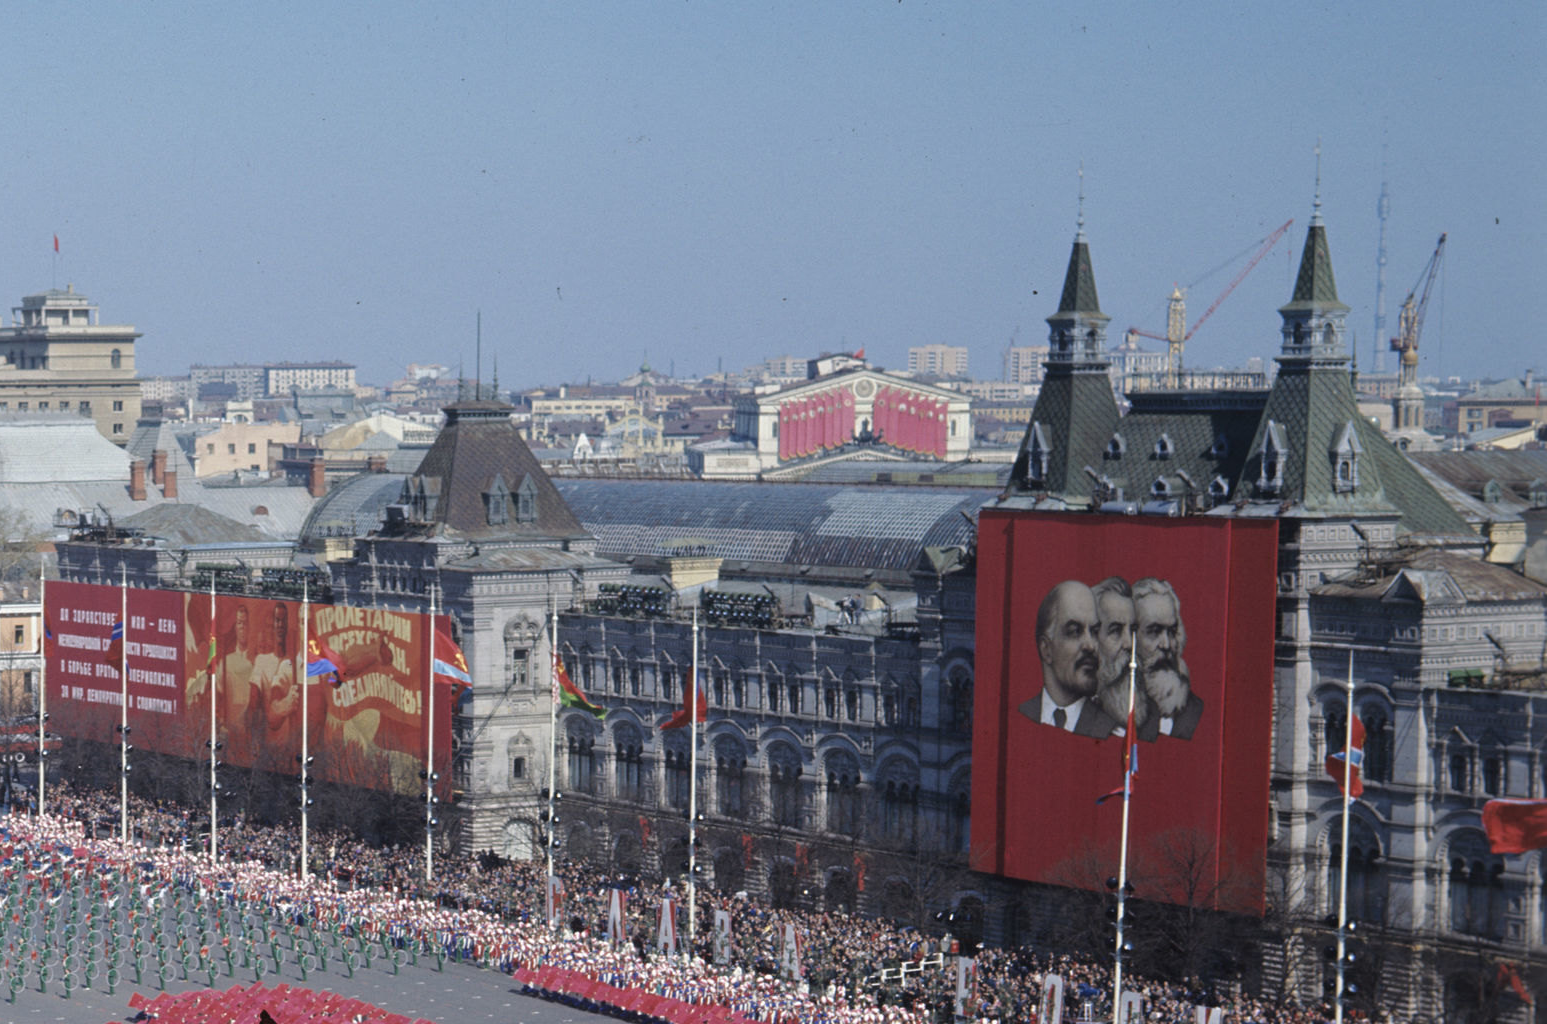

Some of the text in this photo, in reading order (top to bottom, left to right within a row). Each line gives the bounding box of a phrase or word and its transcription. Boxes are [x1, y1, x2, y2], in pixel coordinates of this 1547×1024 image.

[72, 609, 118, 627] ЗДРАВСТВУЕ
[158, 618, 176, 634] ДЕНЬ
[68, 660, 92, 676] БОРЬБЕ
